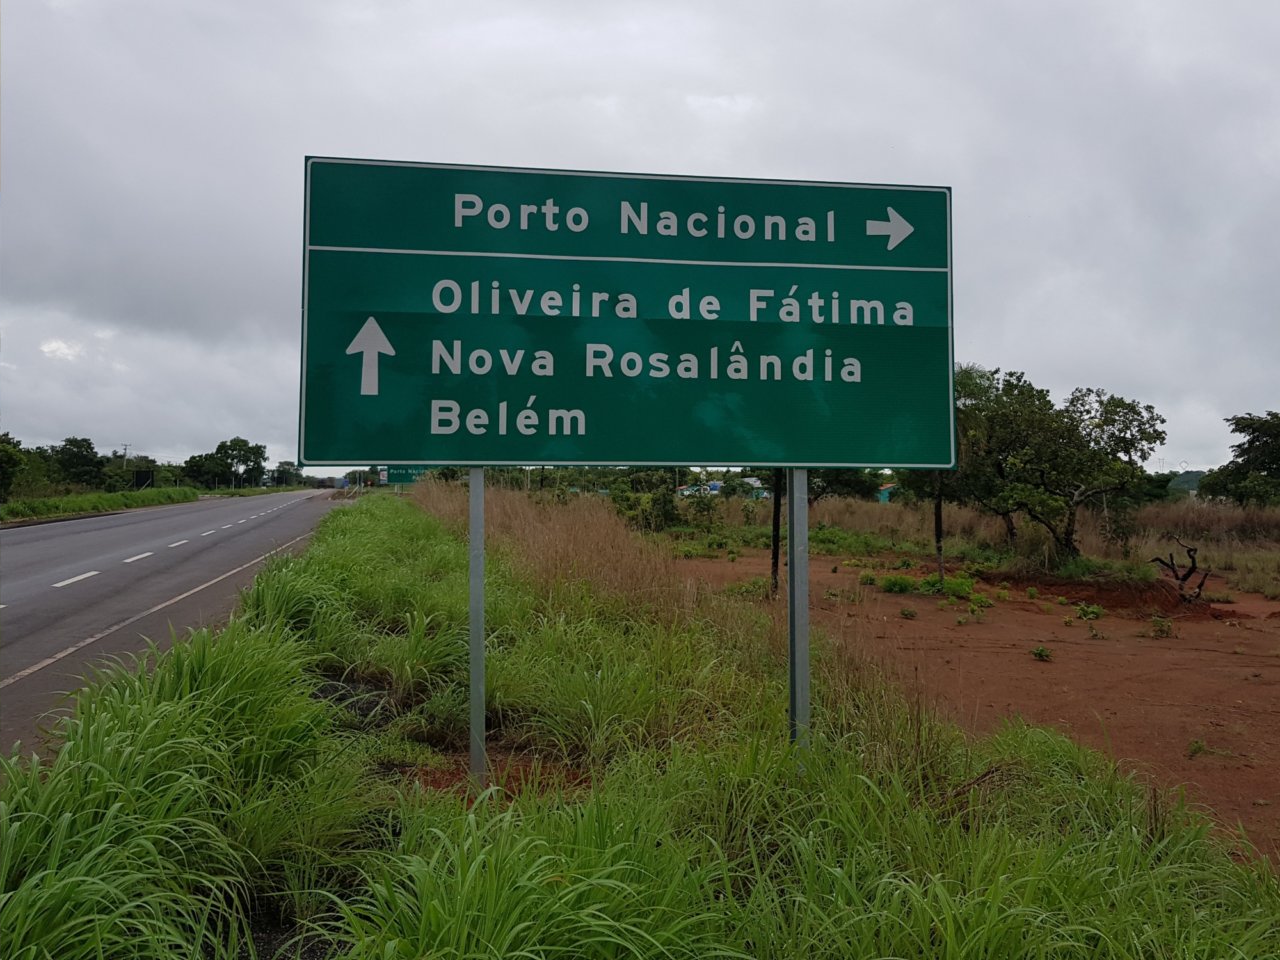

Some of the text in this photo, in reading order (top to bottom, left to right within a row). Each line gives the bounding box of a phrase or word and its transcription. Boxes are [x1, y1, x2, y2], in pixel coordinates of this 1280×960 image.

[454, 193, 835, 242] Porto Nacional
[432, 279, 914, 326] Oliveira de Fátima
[431, 339, 861, 383] Nova Rosalândia
[430, 395, 586, 435] Belém
